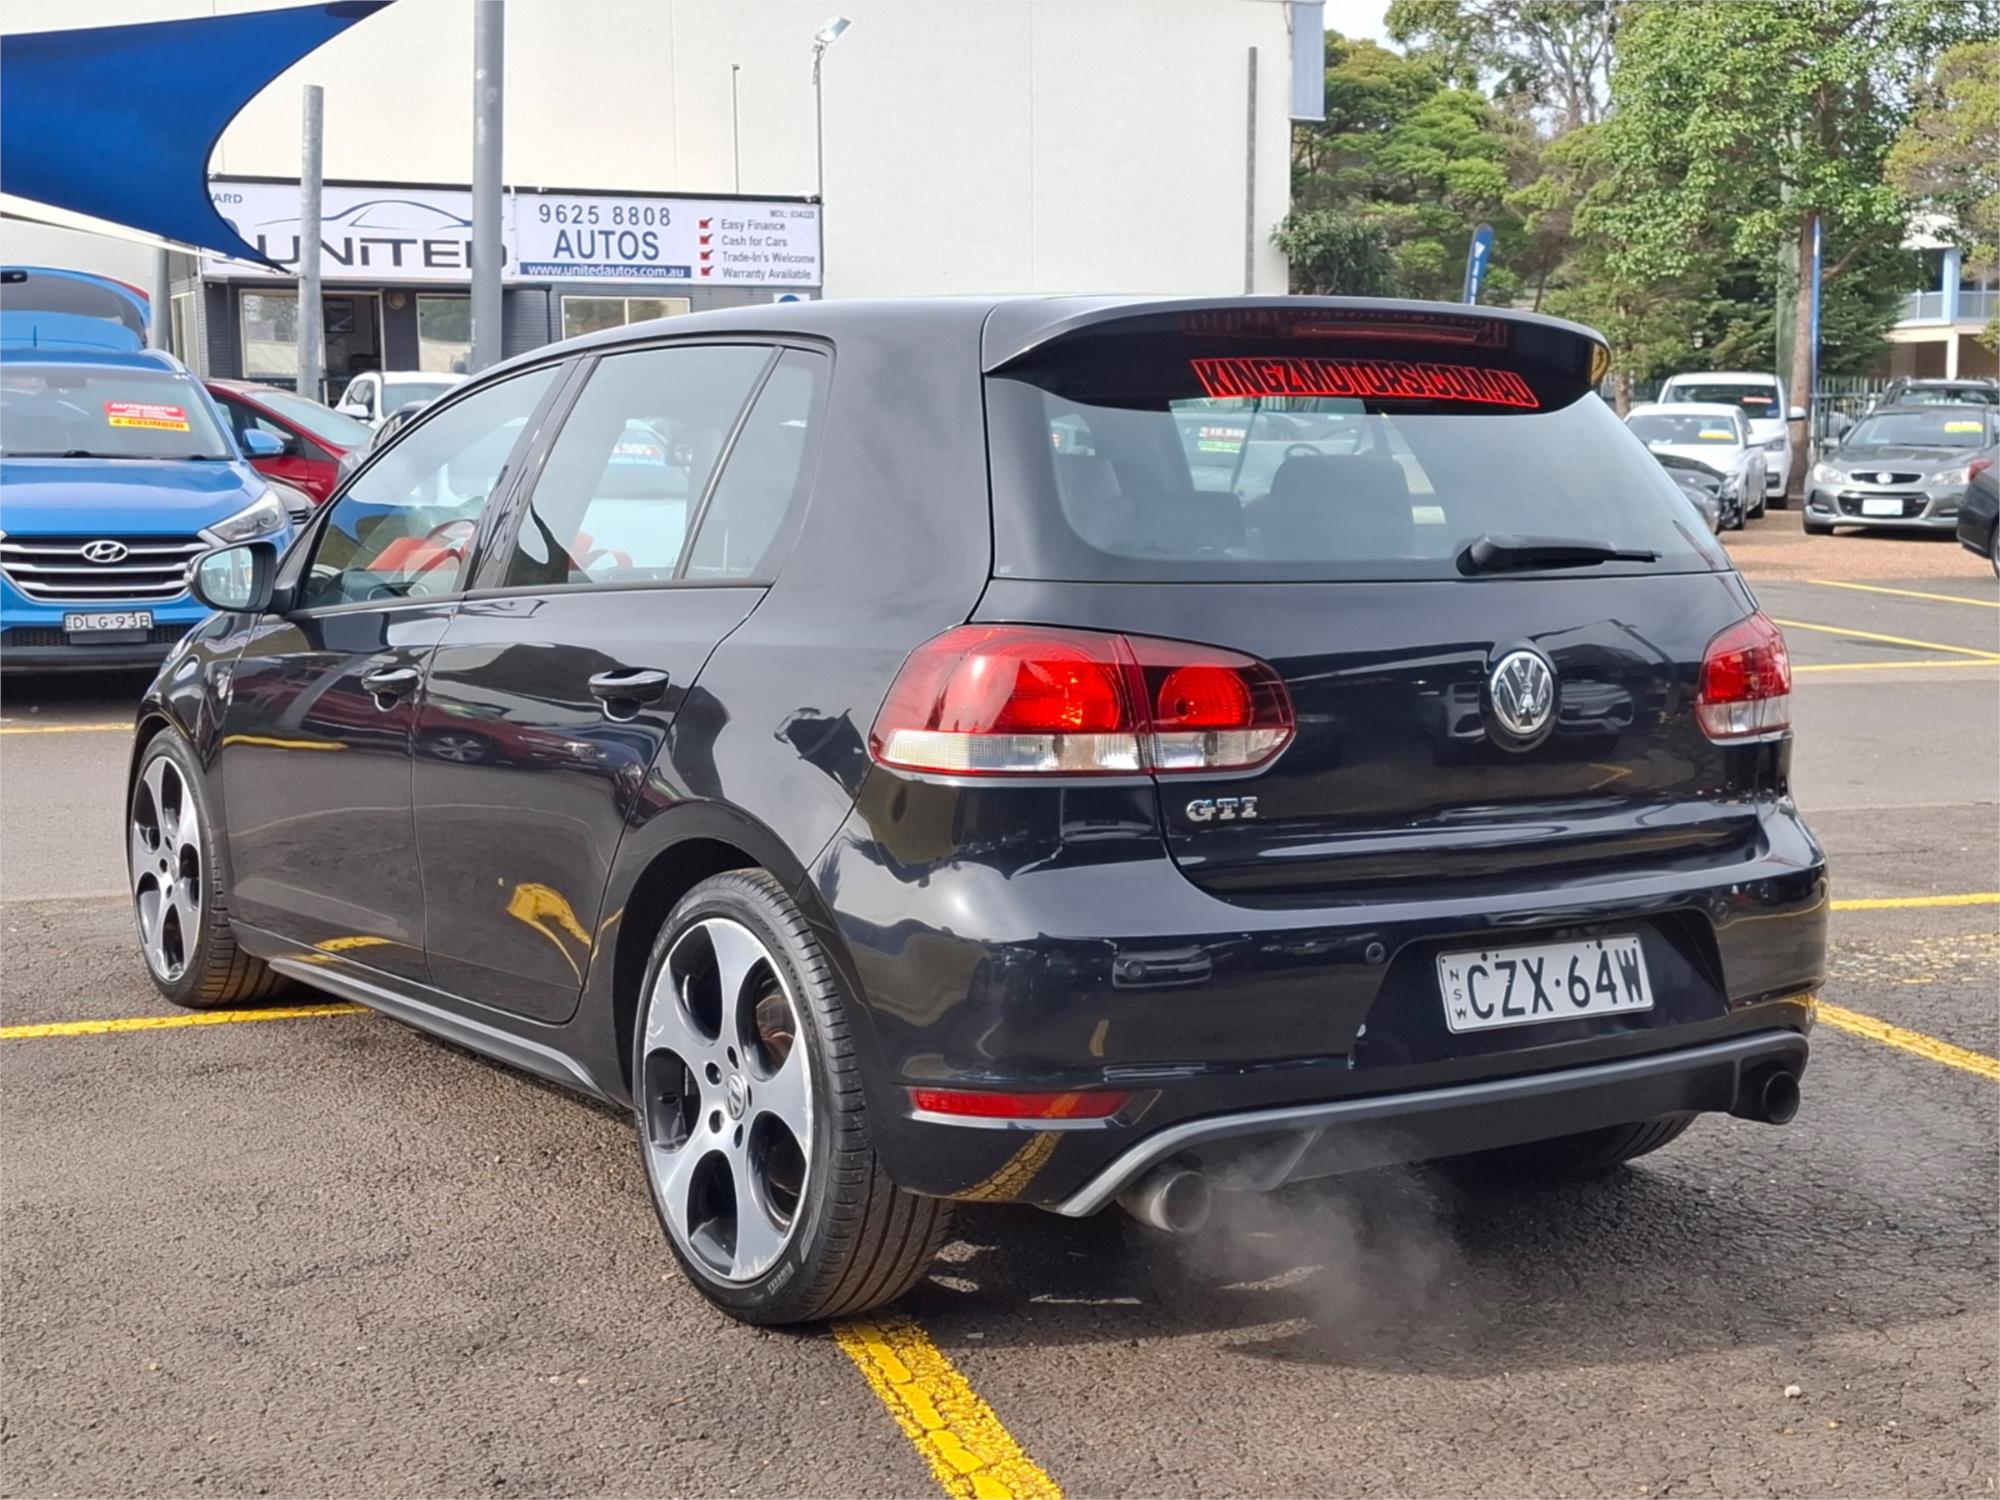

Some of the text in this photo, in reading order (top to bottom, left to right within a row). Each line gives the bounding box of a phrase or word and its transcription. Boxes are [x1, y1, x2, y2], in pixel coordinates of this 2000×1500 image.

[212, 193, 243, 204] ARD
[538, 203, 671, 227] 9625 8808
[721, 219, 786, 232] Easy Finance
[553, 229, 660, 261] AUTOS
[721, 235, 788, 247] Cash for Cars
[771, 252, 815, 264] Welcome
[527, 264, 685, 278] www.unitedautos.com.au
[722, 267, 812, 280] Warranty Available
[1186, 796, 1258, 821] GTI
